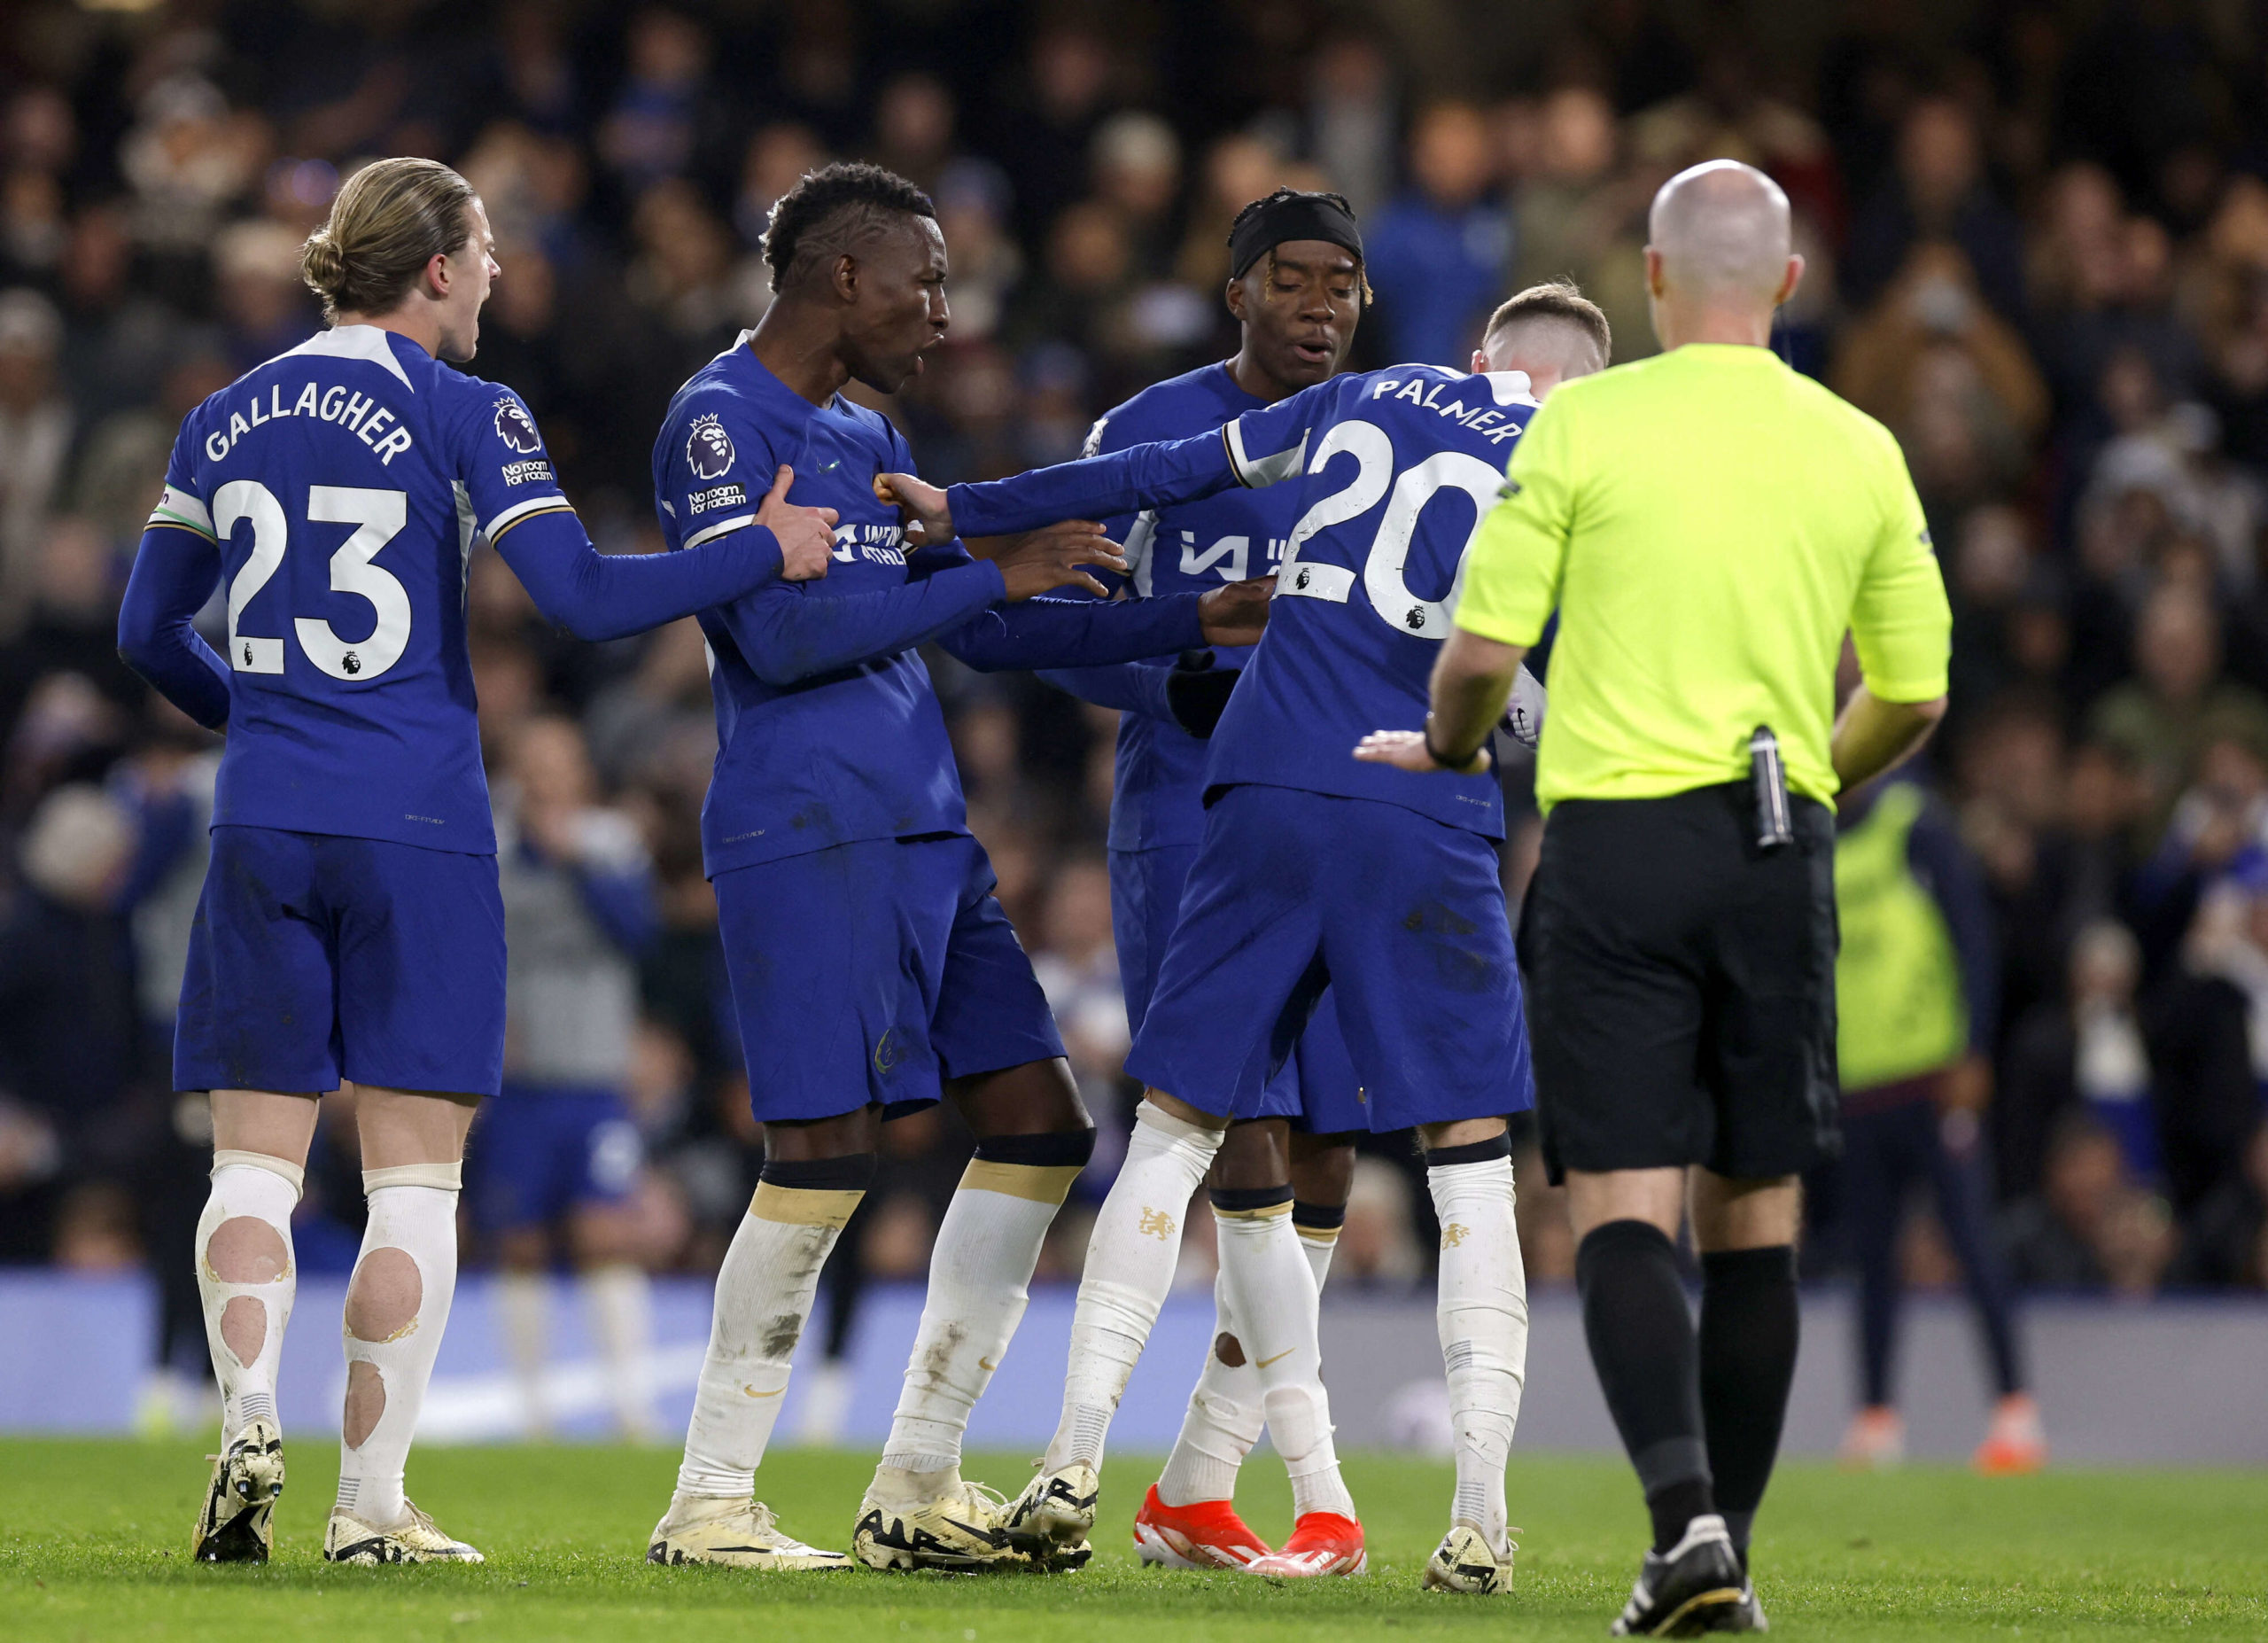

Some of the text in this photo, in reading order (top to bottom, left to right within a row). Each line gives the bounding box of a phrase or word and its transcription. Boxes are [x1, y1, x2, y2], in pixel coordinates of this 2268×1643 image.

[205, 382, 412, 466] GALLAGHER
[1372, 378, 1523, 445] PALMER
[501, 461, 548, 478] No room
[505, 471, 554, 487] for racism
[687, 485, 740, 505] No room
[690, 494, 746, 515] for racism
[865, 524, 904, 547] INFIN
[1270, 419, 1507, 640] 20
[213, 479, 412, 681] 23
[854, 1508, 972, 1557] AIR
